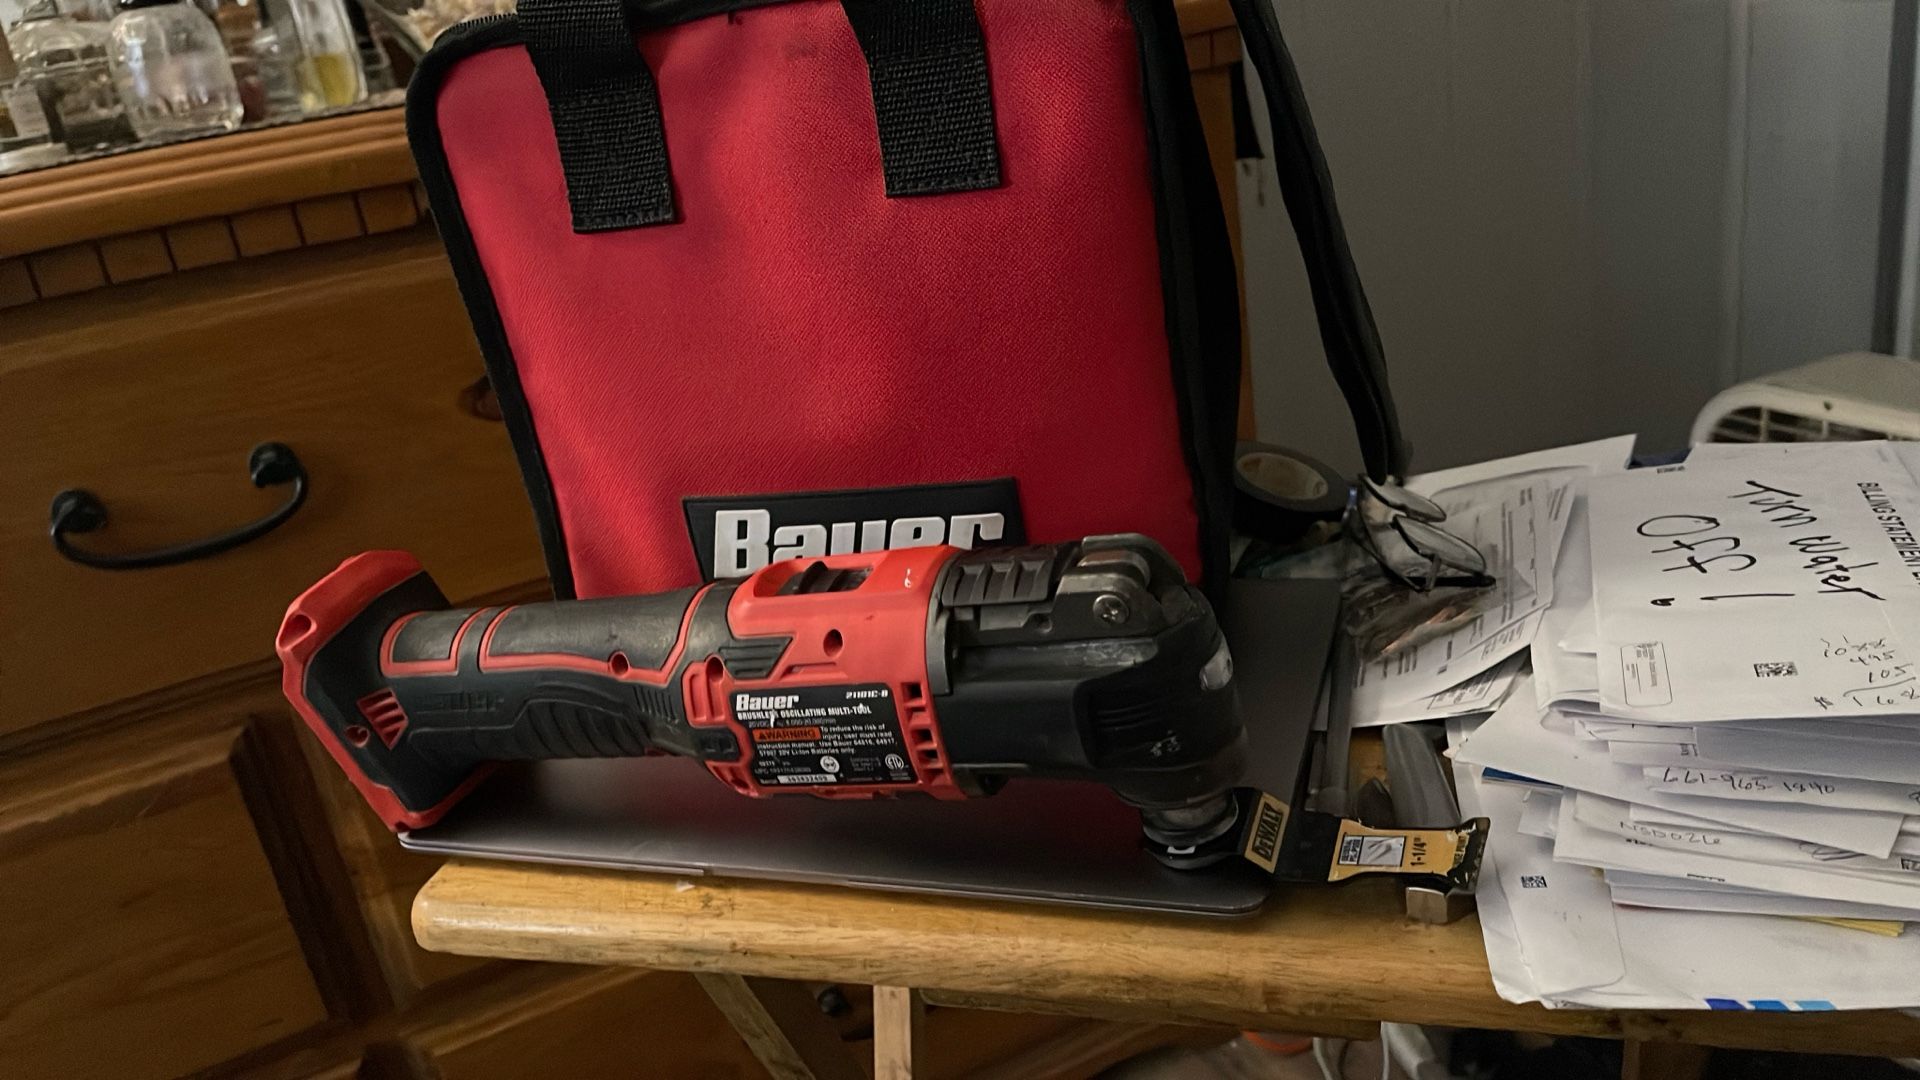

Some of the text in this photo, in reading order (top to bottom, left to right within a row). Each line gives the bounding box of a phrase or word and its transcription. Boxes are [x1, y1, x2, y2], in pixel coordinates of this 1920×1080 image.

[1856, 482, 1897, 514] BILLING
[714, 509, 1004, 578] Bauer
[1727, 479, 1887, 601] Turn Water
[736, 693, 799, 712] Bauer
[780, 707, 827, 719] OSCILLATING
[827, 704, 873, 716] MULTI-TOOL
[764, 728, 816, 739] WARNING
[829, 724, 852, 733] reduce
[864, 723, 877, 731] risk
[859, 731, 877, 739] must
[877, 730, 893, 738] read
